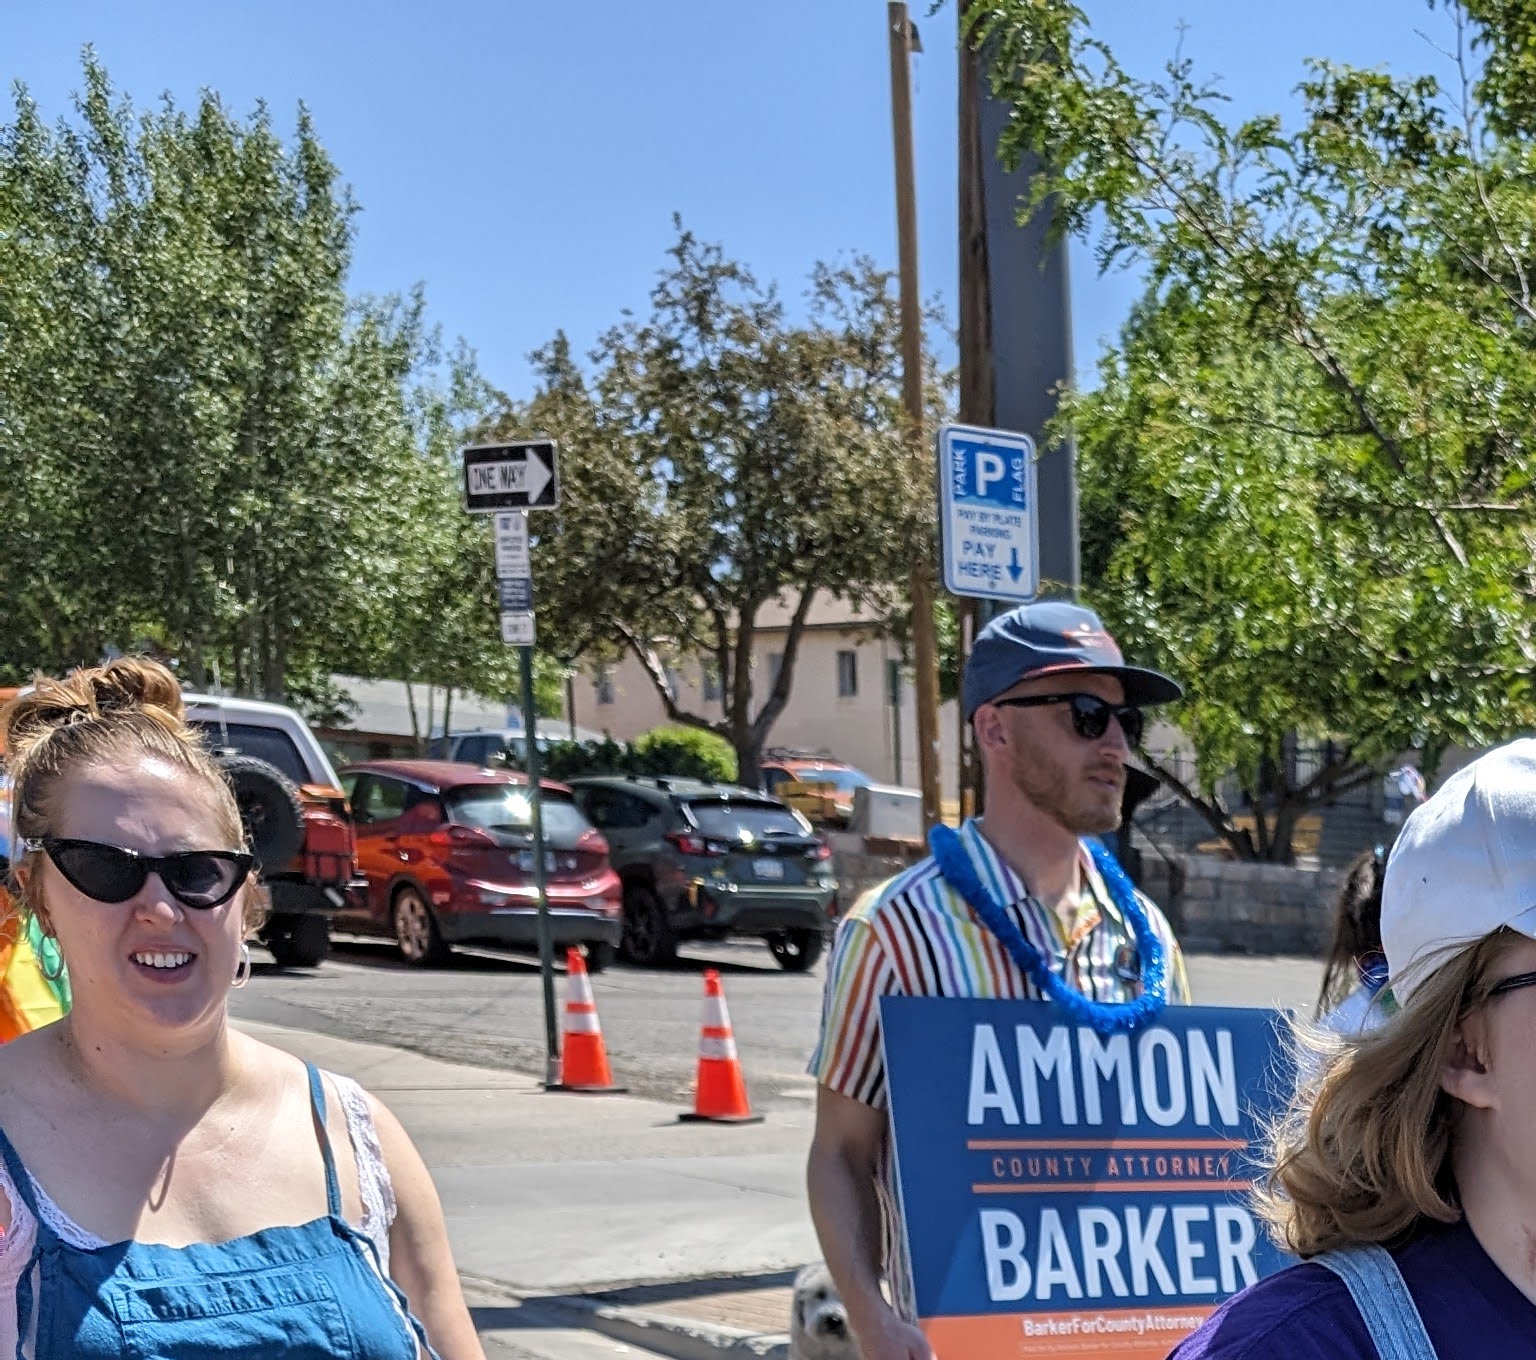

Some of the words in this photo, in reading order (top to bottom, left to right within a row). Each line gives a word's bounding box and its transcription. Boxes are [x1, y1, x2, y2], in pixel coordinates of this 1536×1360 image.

[473, 466, 496, 491] ONE
[500, 464, 528, 489] WAY
[953, 448, 967, 496] PARK
[975, 451, 1007, 496] P
[962, 540, 997, 559] PAY
[958, 560, 1002, 580] HERE
[968, 1024, 1240, 1126] AMMON
[992, 1155, 1093, 1177] COUNTY
[1108, 1156, 1231, 1177] ATTORNEY
[979, 1205, 1260, 1301] BARKER
